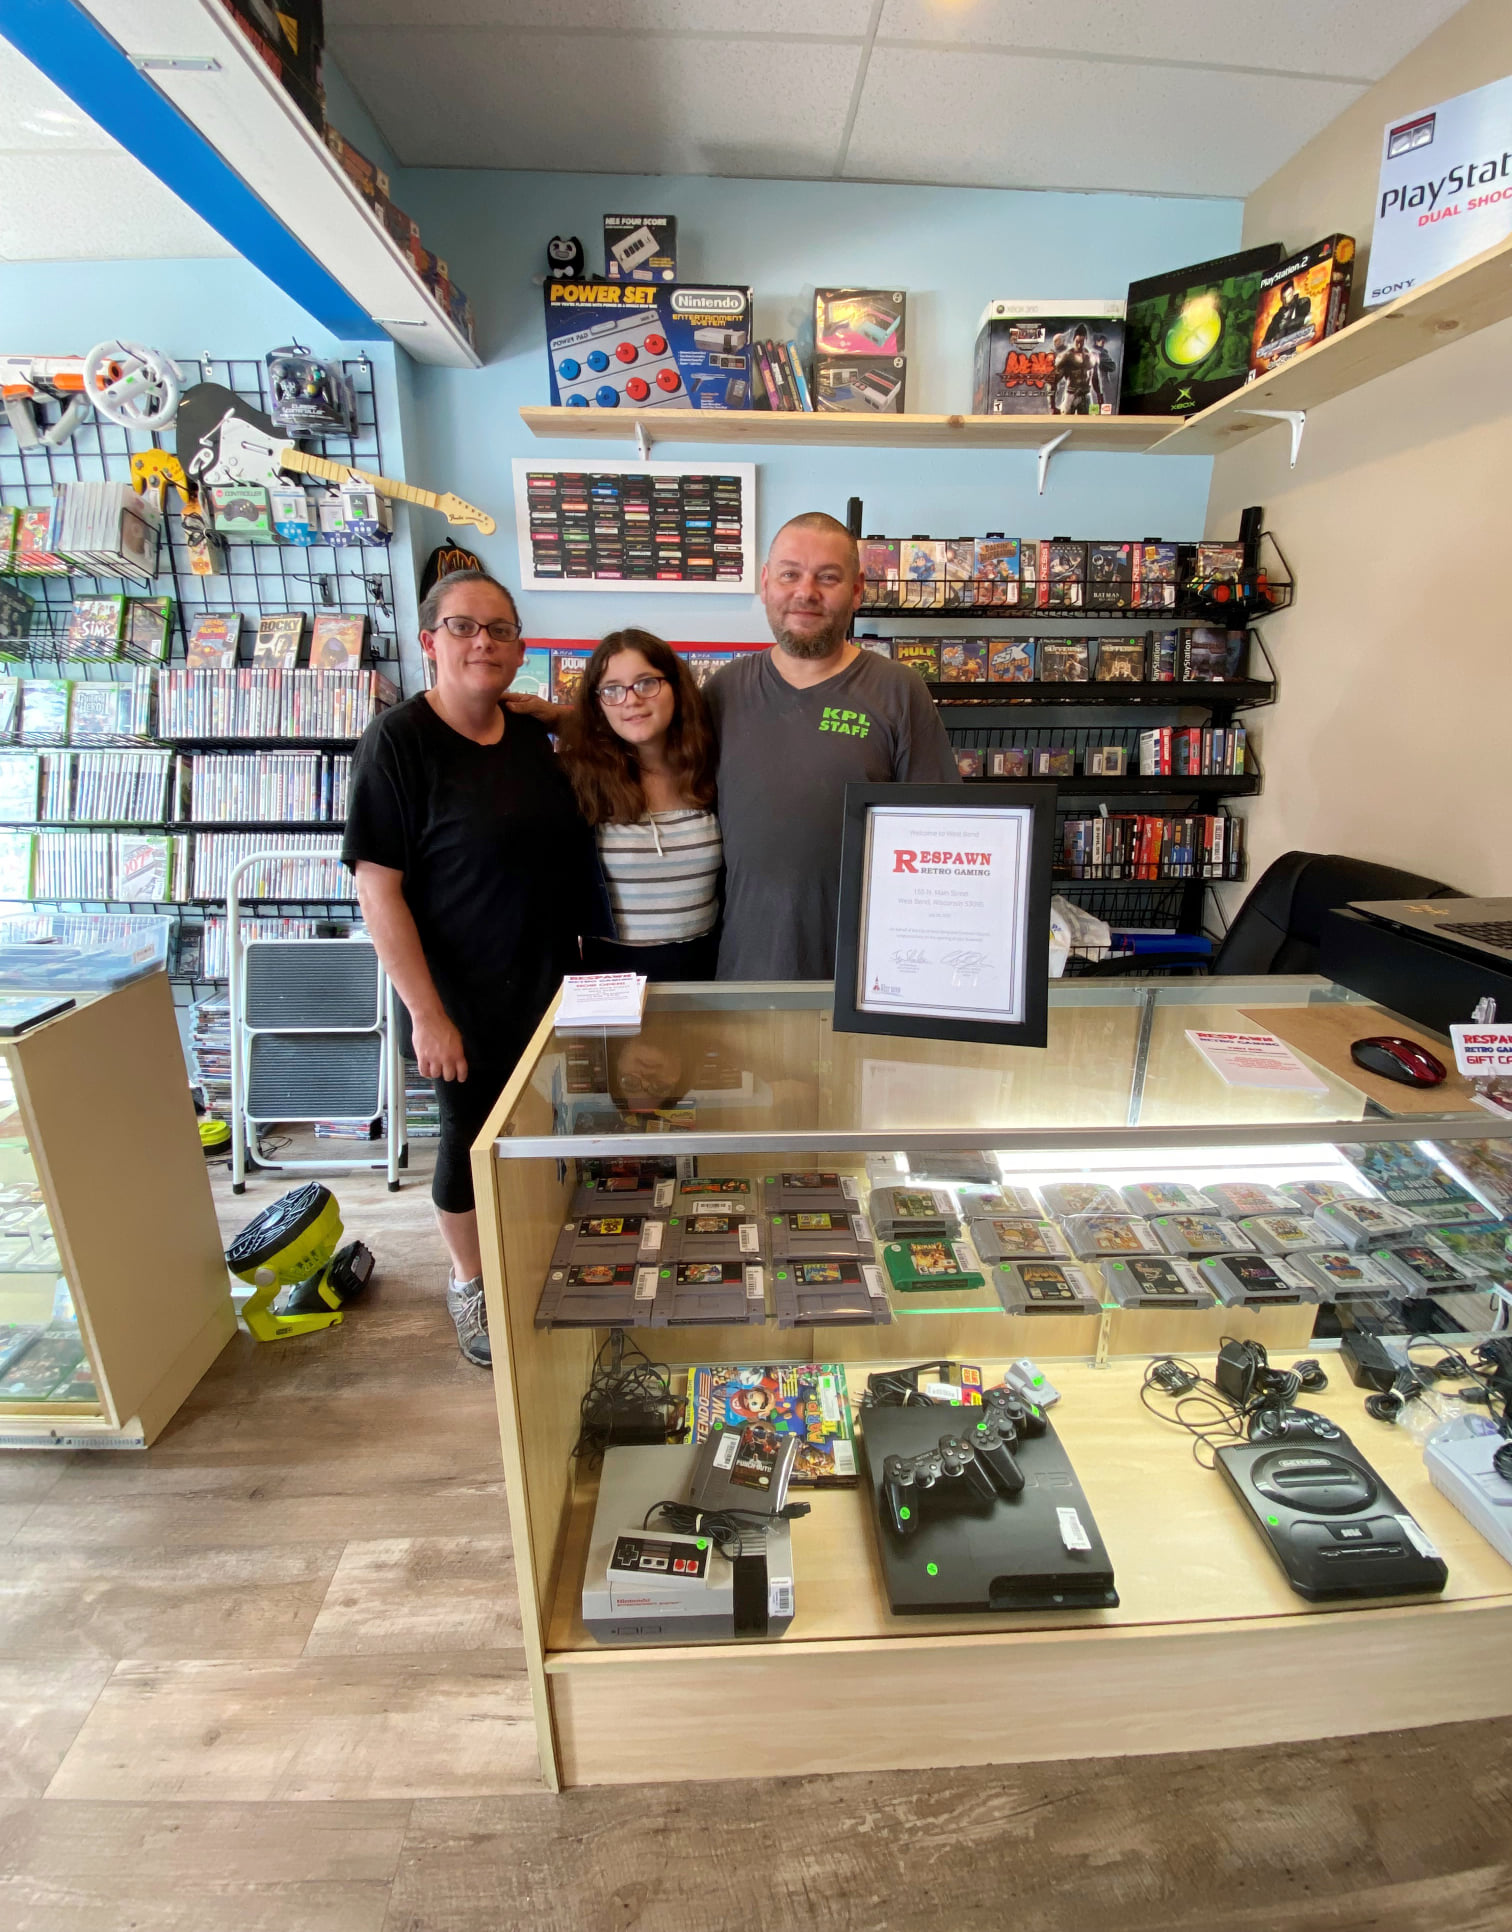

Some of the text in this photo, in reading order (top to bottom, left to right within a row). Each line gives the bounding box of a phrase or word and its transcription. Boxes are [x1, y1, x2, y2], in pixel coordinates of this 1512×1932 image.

[1418, 204, 1461, 227] DUAL
[550, 284, 658, 304] POWER SET
[1371, 279, 1416, 298] SONY
[678, 295, 739, 309] Nintendo
[1170, 400, 1196, 411] XBOX
[260, 619, 300, 632] ROCKY
[898, 647, 936, 659] HULK
[561, 657, 586, 671] DOOM
[822, 707, 870, 726] KPL
[818, 720, 869, 738] STAFF
[892, 850, 992, 874] RESPAWN
[920, 868, 991, 877] RETRO GAMING
[1463, 1034, 1512, 1044] RESPA
[1466, 1055, 1494, 1064] GIFT
[697, 1396, 710, 1446] TENDO
